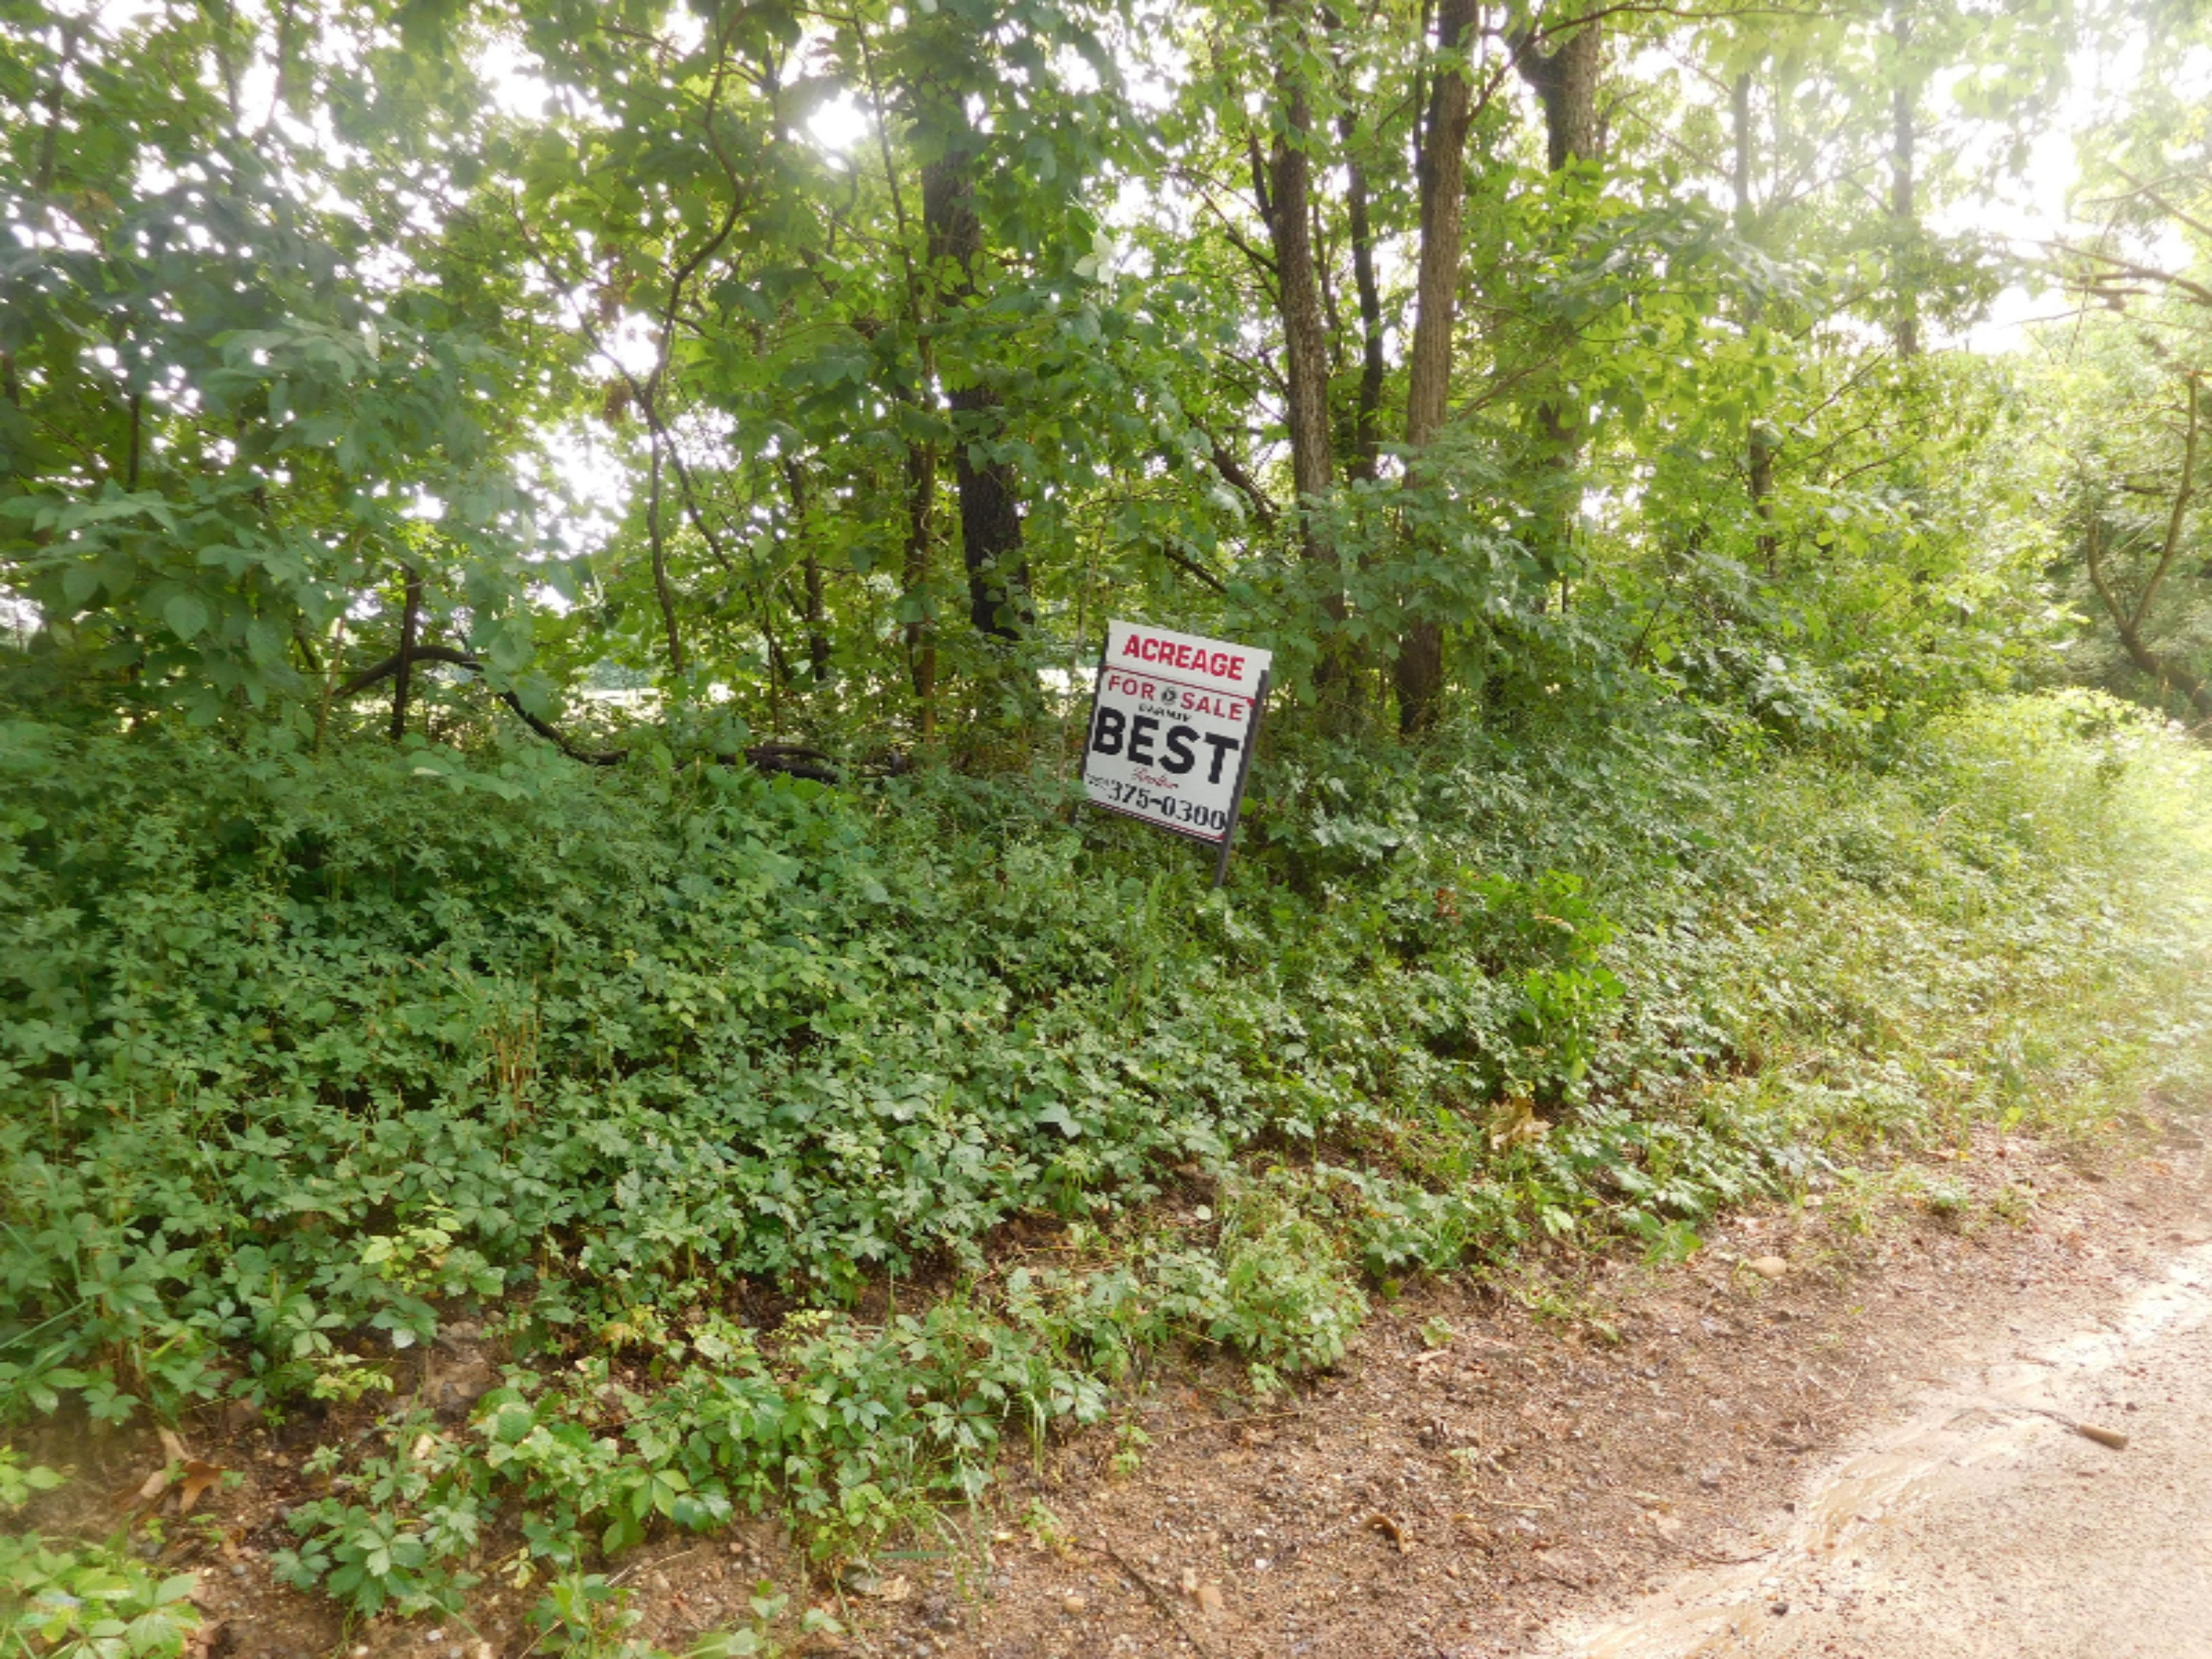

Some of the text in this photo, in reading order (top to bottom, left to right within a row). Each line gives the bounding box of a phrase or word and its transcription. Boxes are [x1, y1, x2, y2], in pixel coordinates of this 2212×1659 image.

[1122, 634, 1245, 681] ACREAGE
[1108, 675, 1155, 700] FOR
[1180, 692, 1244, 720] SALE
[1092, 706, 1239, 784] BEST
[1108, 781, 1227, 830] 375-0300
